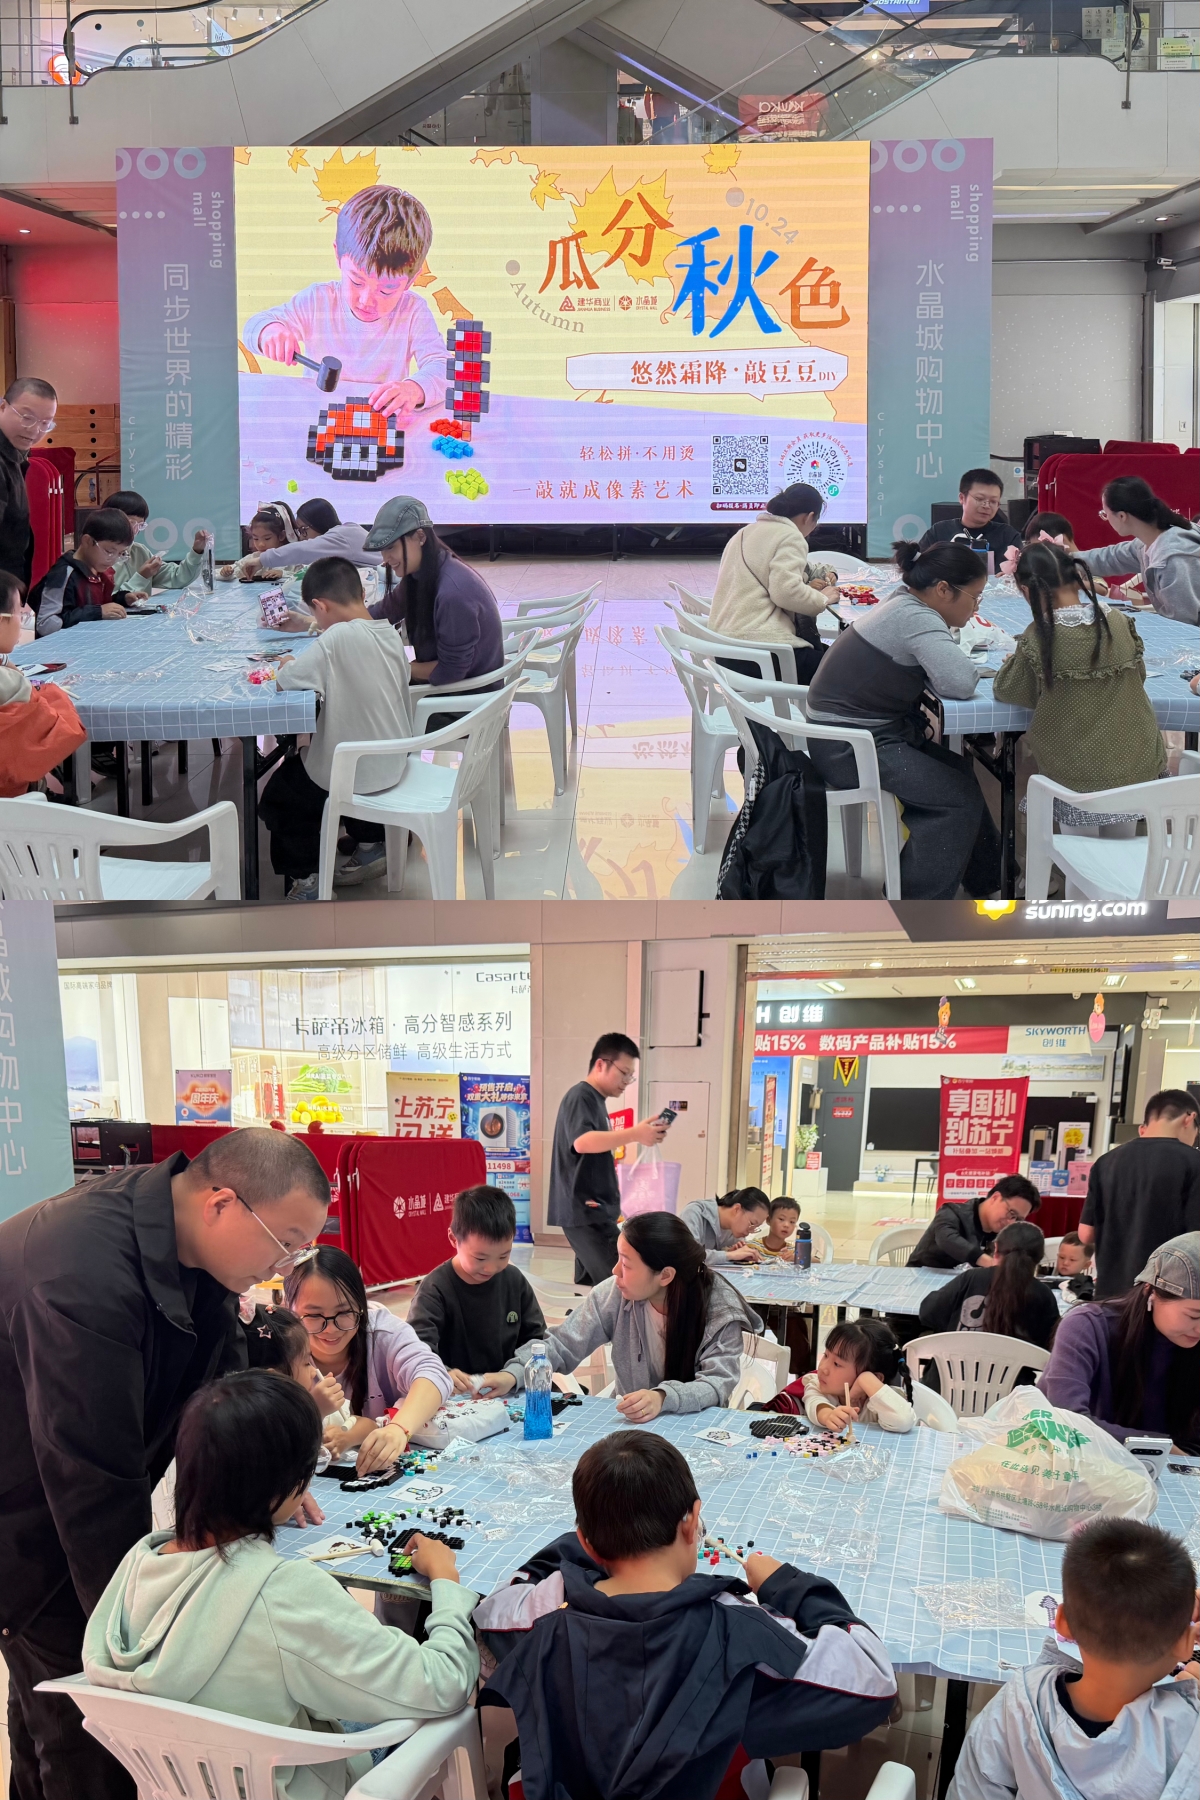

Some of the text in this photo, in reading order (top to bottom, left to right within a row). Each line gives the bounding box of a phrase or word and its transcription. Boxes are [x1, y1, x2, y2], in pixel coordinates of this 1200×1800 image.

[192, 191, 204, 227] mall
[950, 185, 964, 221] mall
[208, 191, 225, 270] shopping
[744, 196, 800, 246] 10.24
[967, 184, 983, 263] shopping
[538, 192, 850, 338] 瓜分秋色
[509, 280, 586, 335] Autumn
[162, 262, 194, 482] 同步世界的精彩
[914, 258, 946, 480] 水晶城购物中心
[512, 478, 696, 501] 一敲就成像素艺术
[1025, 902, 1147, 922] suning.com
[779, 1004, 824, 1023] 创维
[1025, 1026, 1087, 1036] SKYWORTH
[1042, 1039, 1067, 1048] 创维
[317, 1041, 512, 1061] 高级分区储鲜 高级生活方式
[190, 1093, 220, 1105] 周年庆
[394, 1095, 455, 1119] 上苏宁
[947, 1088, 1017, 1117] 享国补
[944, 1117, 1015, 1145] 到苏宁
[408, 1194, 427, 1210] 水晶城
